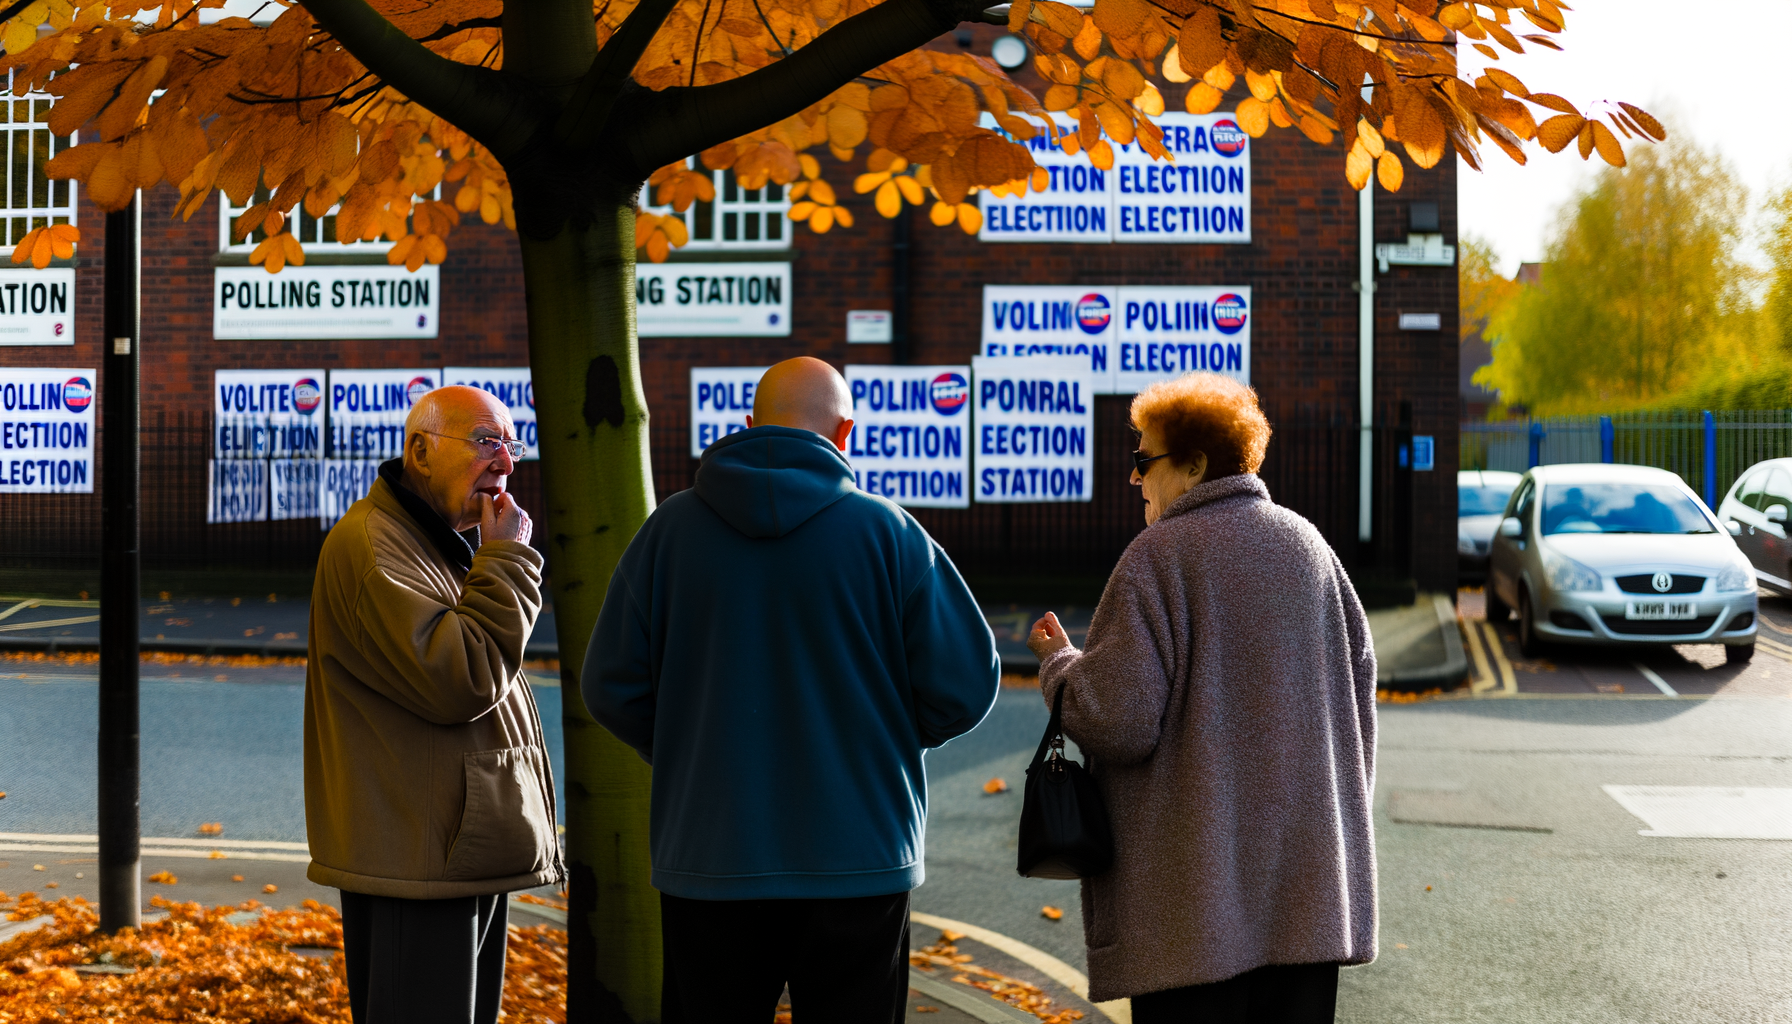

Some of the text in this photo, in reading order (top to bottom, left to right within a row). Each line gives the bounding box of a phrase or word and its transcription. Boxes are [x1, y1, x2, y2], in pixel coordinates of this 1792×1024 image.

[221, 280, 430, 308] POLLING STATION
[677, 277, 782, 304] STATION
[0, 383, 60, 411] OLLIN
[221, 384, 289, 412] VOLITE
[699, 383, 759, 410] POLE
[981, 379, 1086, 413] PONRAL
[981, 425, 1085, 455] EECTION
[981, 468, 1083, 496] STATION
